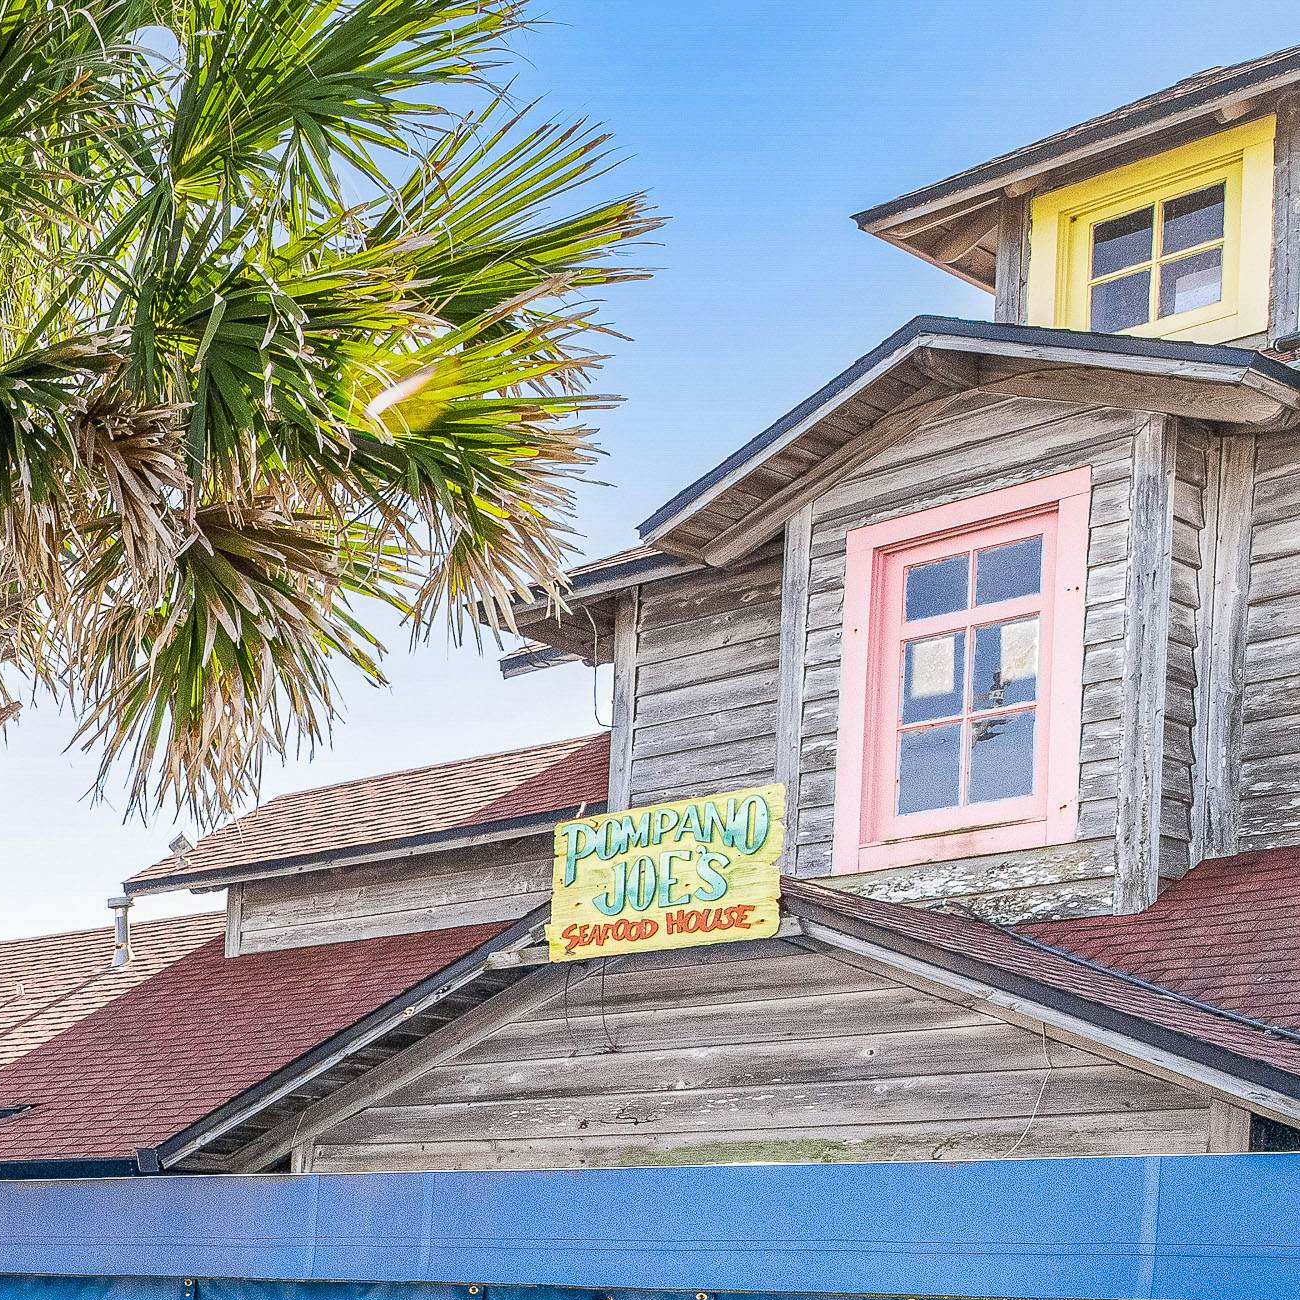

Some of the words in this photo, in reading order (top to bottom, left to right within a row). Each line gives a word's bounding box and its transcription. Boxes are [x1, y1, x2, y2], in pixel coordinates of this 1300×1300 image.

[562, 794, 769, 888] POMPANO
[592, 845, 730, 917] JOE'S
[561, 918, 659, 951] SEAFOOD
[665, 904, 755, 935] HOUSE
